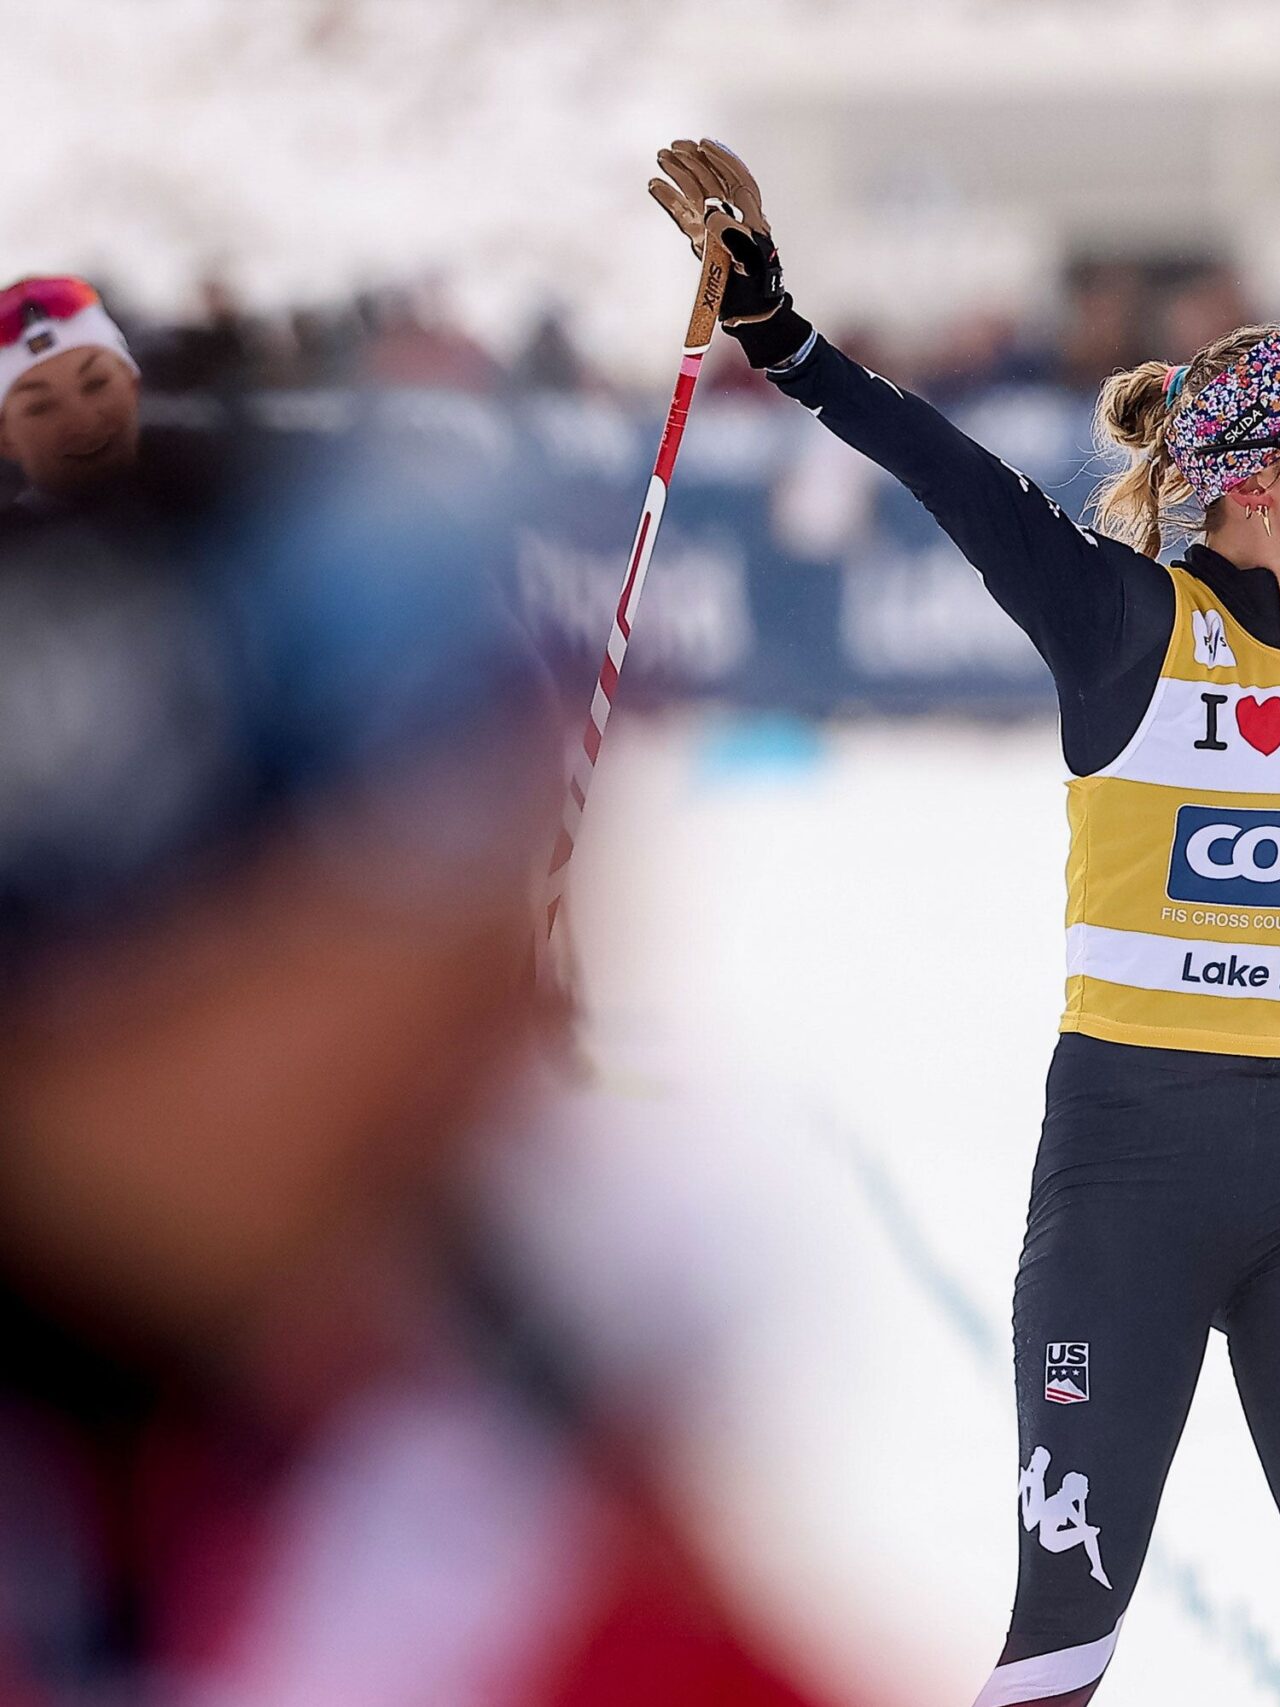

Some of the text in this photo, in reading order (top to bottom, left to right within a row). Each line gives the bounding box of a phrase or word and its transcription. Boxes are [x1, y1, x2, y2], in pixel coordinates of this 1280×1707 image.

[1224, 409, 1263, 444] SKIDA
[1194, 693, 1228, 751] I
[1161, 907, 1187, 923] FIS
[1192, 911, 1250, 928] CROSS
[1181, 952, 1270, 988] Lake
[1048, 1344, 1087, 1365] US
